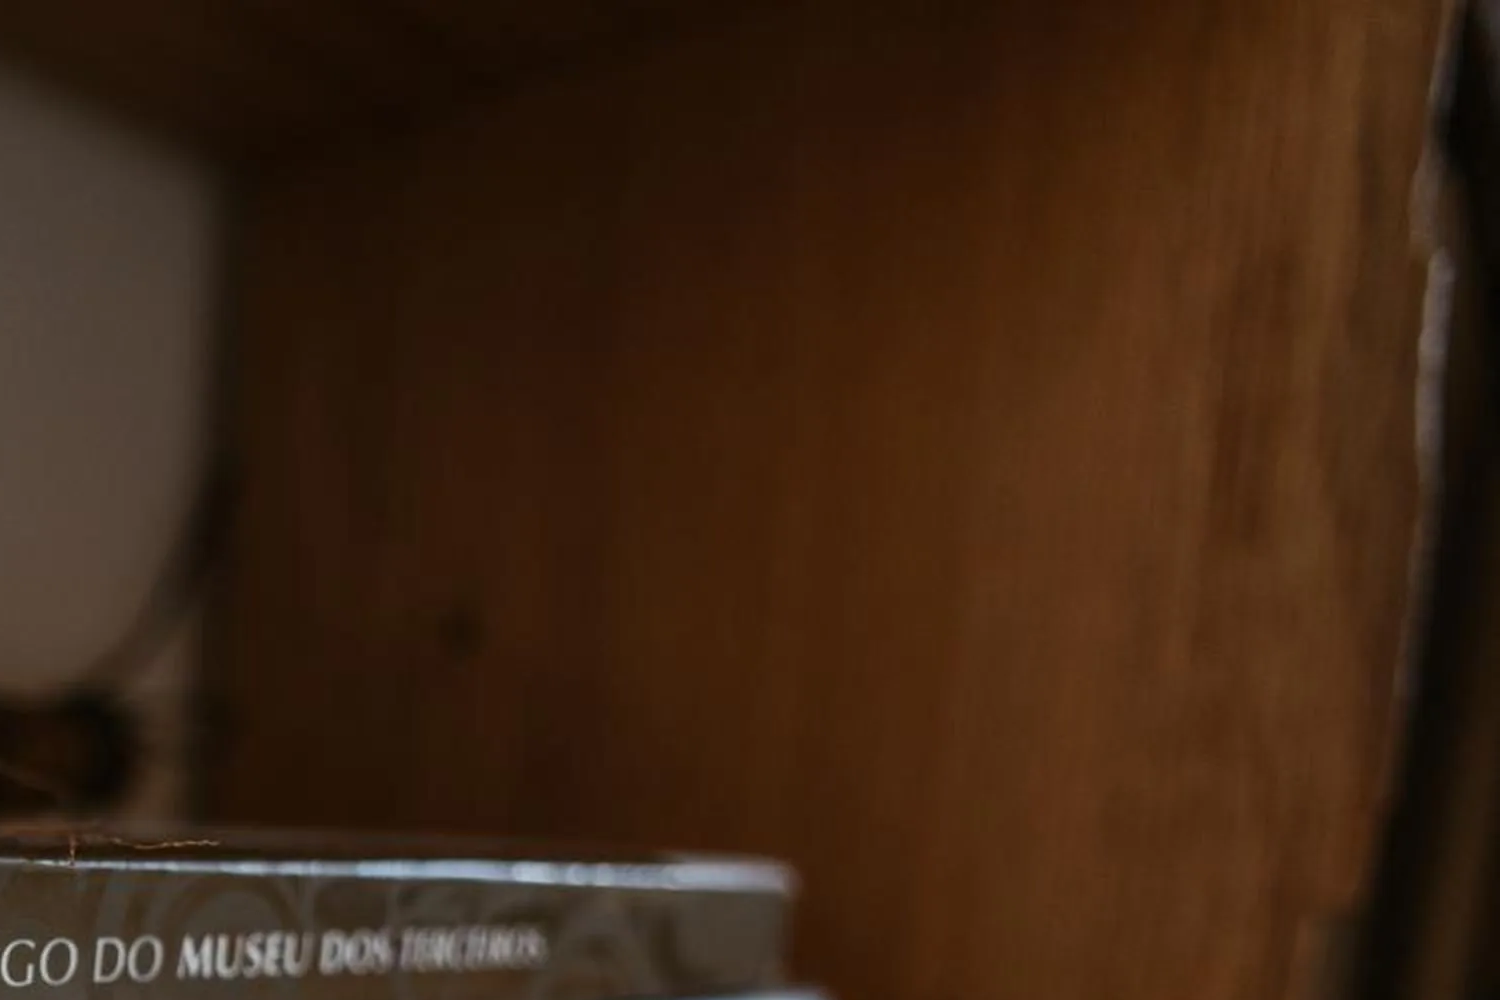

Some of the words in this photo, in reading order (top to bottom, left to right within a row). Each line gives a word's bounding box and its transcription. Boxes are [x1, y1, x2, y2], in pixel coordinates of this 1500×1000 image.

[92, 935, 164, 984] DO
[176, 932, 308, 979] MUSEU
[319, 928, 395, 976] DOS
